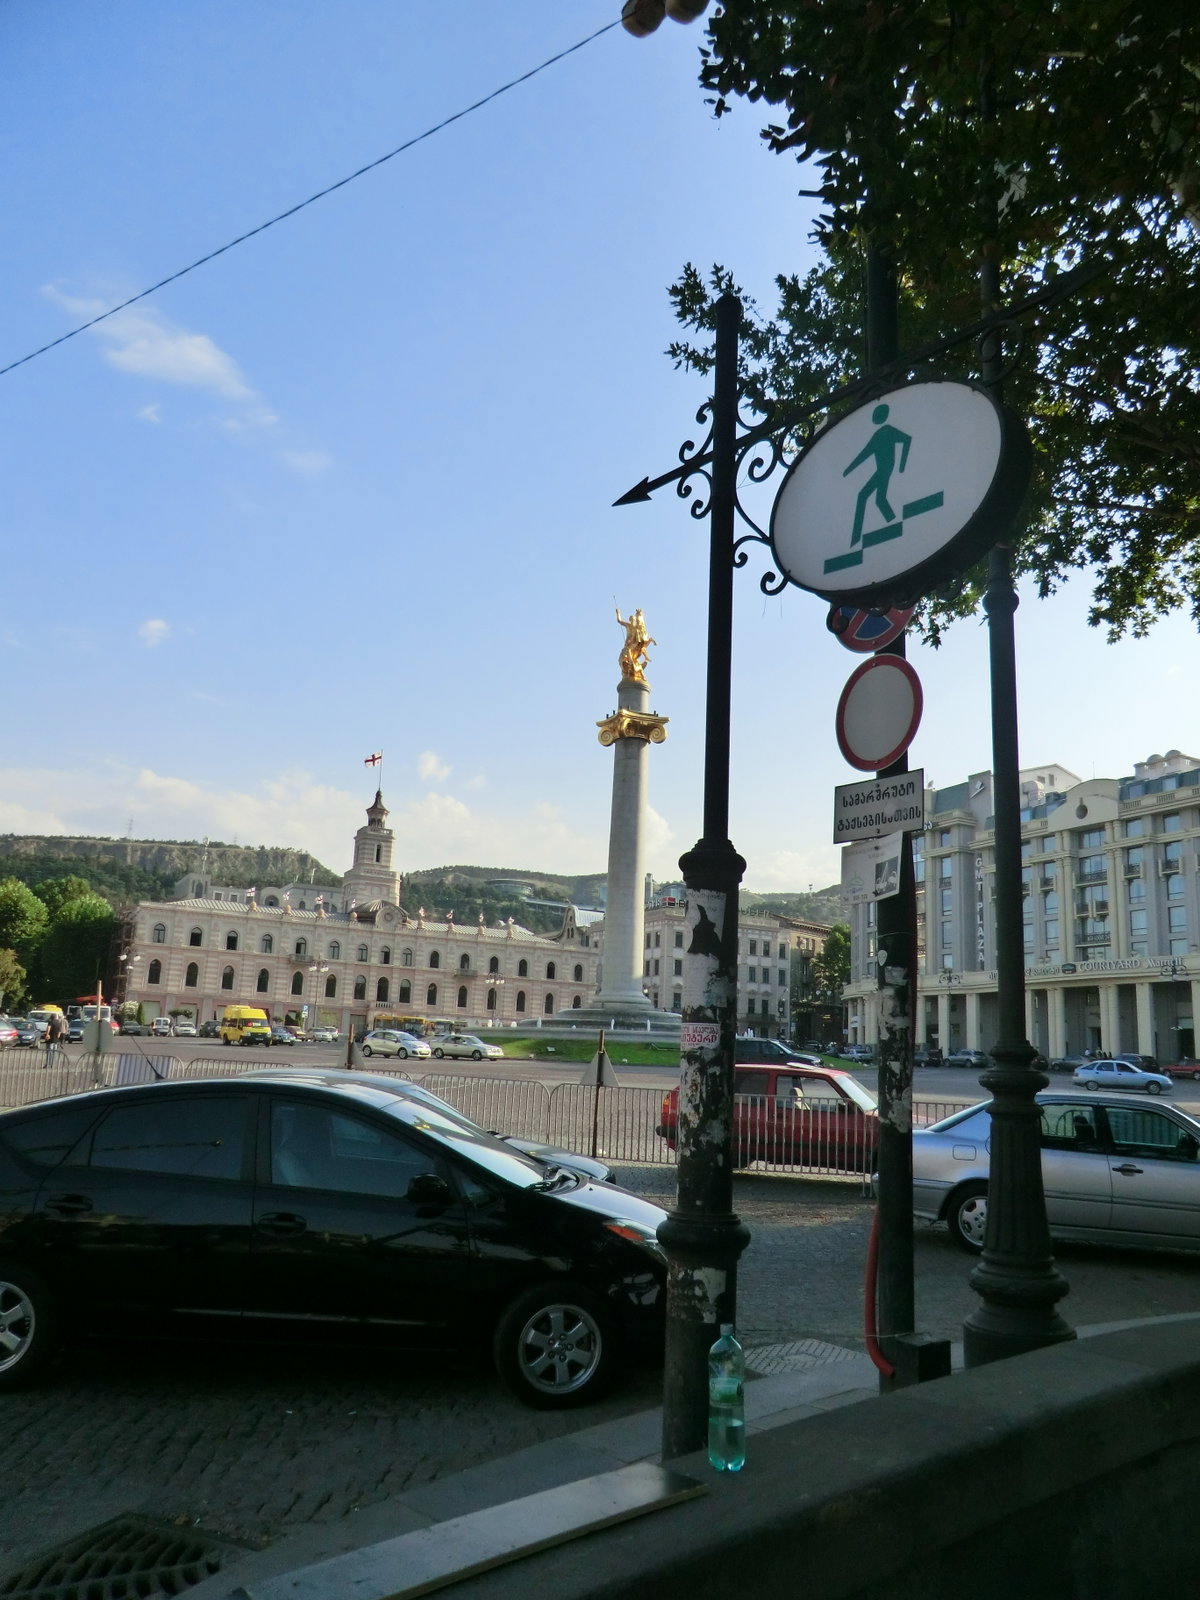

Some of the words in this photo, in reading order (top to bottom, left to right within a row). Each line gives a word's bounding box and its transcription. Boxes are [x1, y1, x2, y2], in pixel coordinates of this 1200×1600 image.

[843, 782, 915, 807] სამარშრუტო
[837, 806, 921, 831] ტაქსებისათვის
[975, 858, 983, 891] GMT
[977, 902, 985, 961] PLAZA
[1079, 959, 1140, 972] COURTYARD
